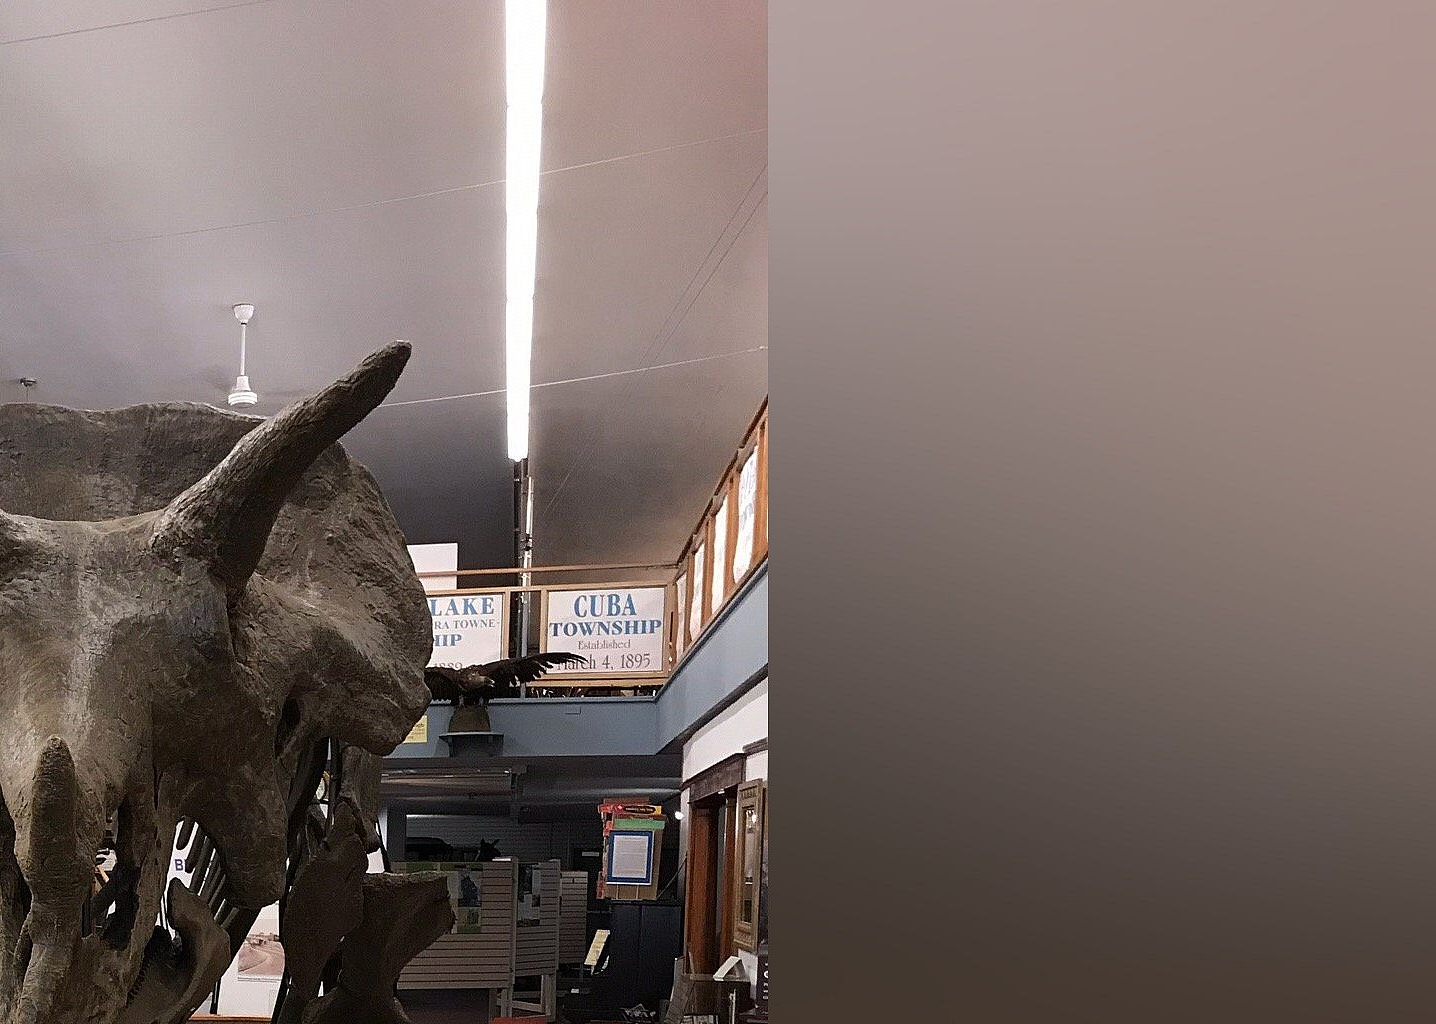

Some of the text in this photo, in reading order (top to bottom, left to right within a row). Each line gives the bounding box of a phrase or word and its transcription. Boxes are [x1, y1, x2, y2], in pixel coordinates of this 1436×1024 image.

[430, 597, 495, 617] LAKE
[574, 593, 637, 618] CUBA
[549, 619, 662, 637] TOWNSHIP
[577, 639, 632, 650] Established
[602, 655, 614, 670] 4,
[621, 653, 652, 670] 1895
